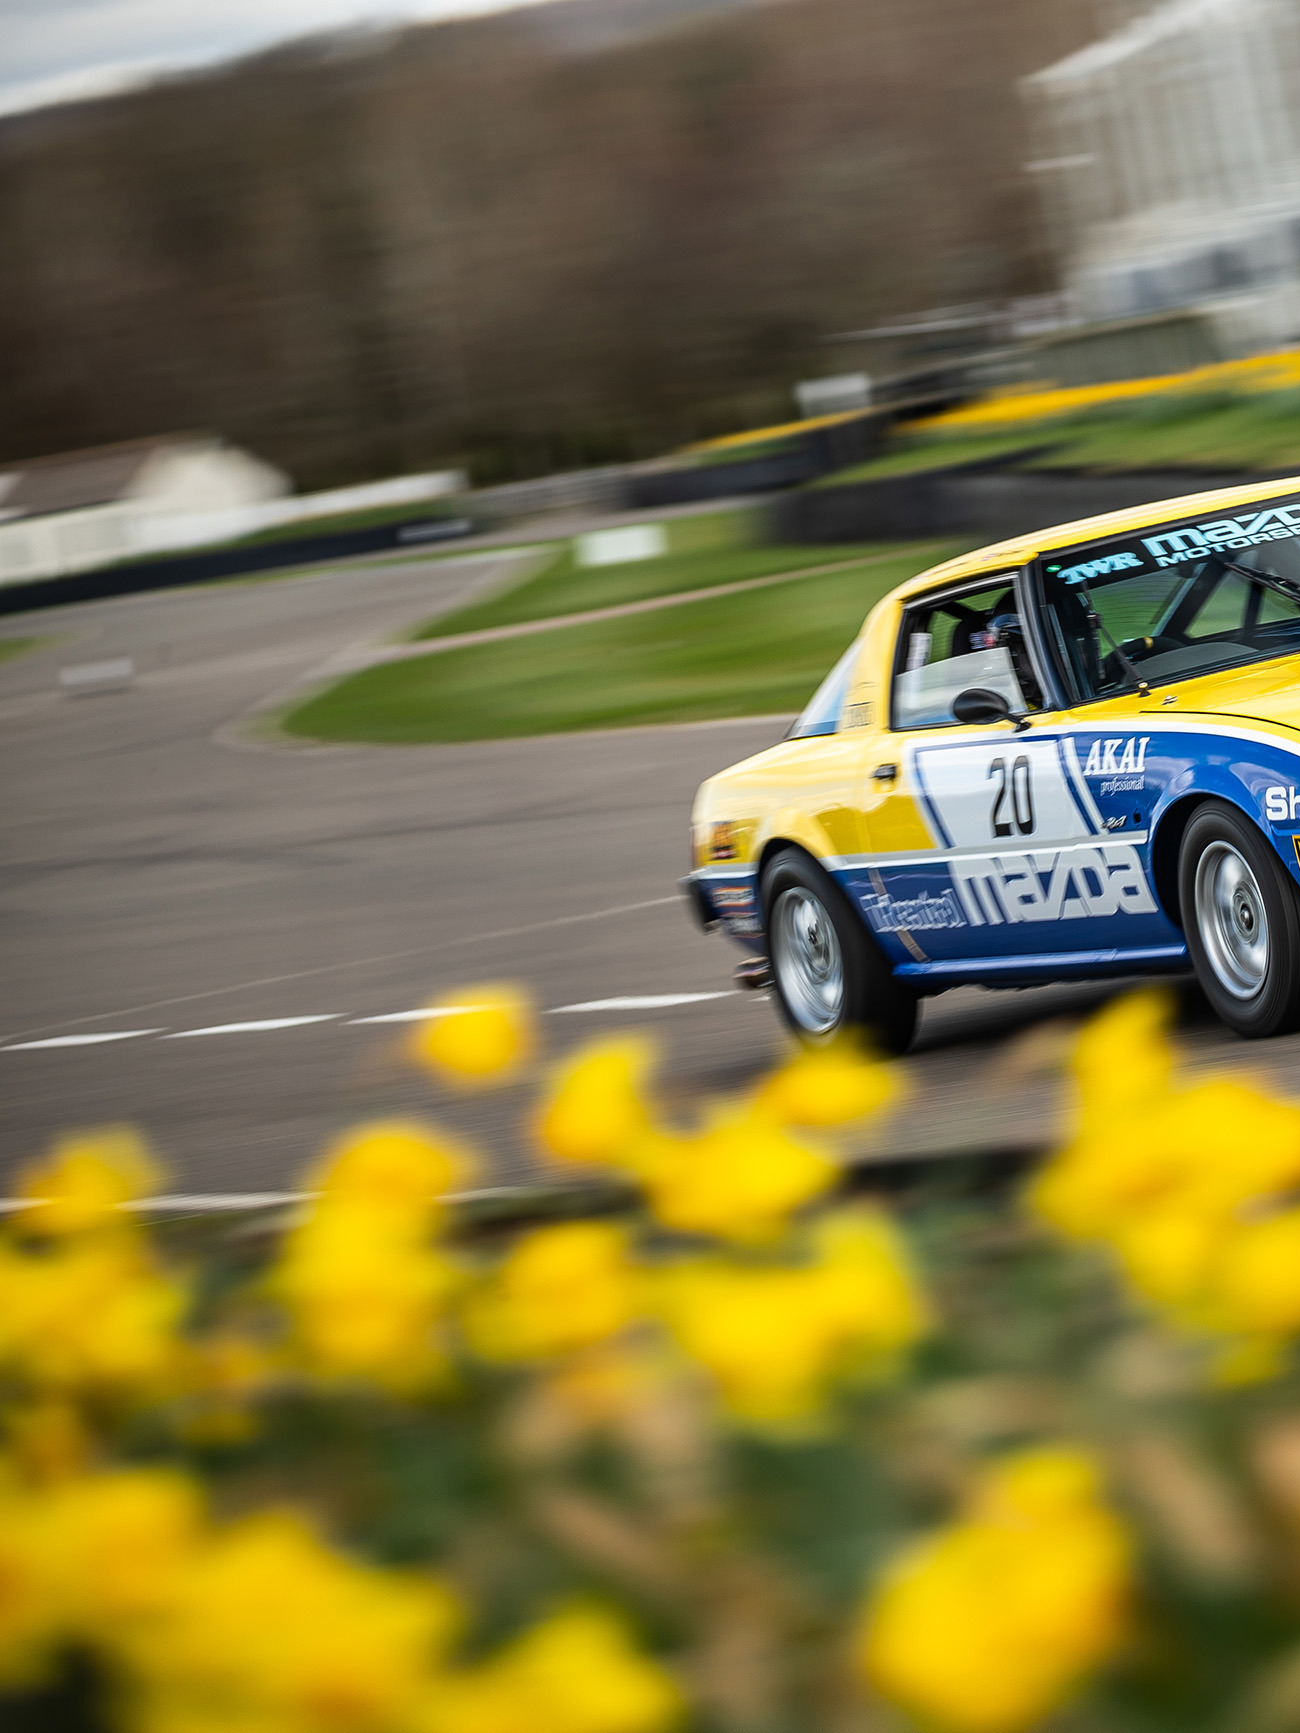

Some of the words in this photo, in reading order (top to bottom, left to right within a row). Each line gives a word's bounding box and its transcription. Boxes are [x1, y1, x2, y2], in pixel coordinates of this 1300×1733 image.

[1056, 552, 1145, 585] TWR
[1082, 736, 1151, 777] AKAI
[985, 754, 1034, 839] 20
[1100, 774, 1146, 797] professional
